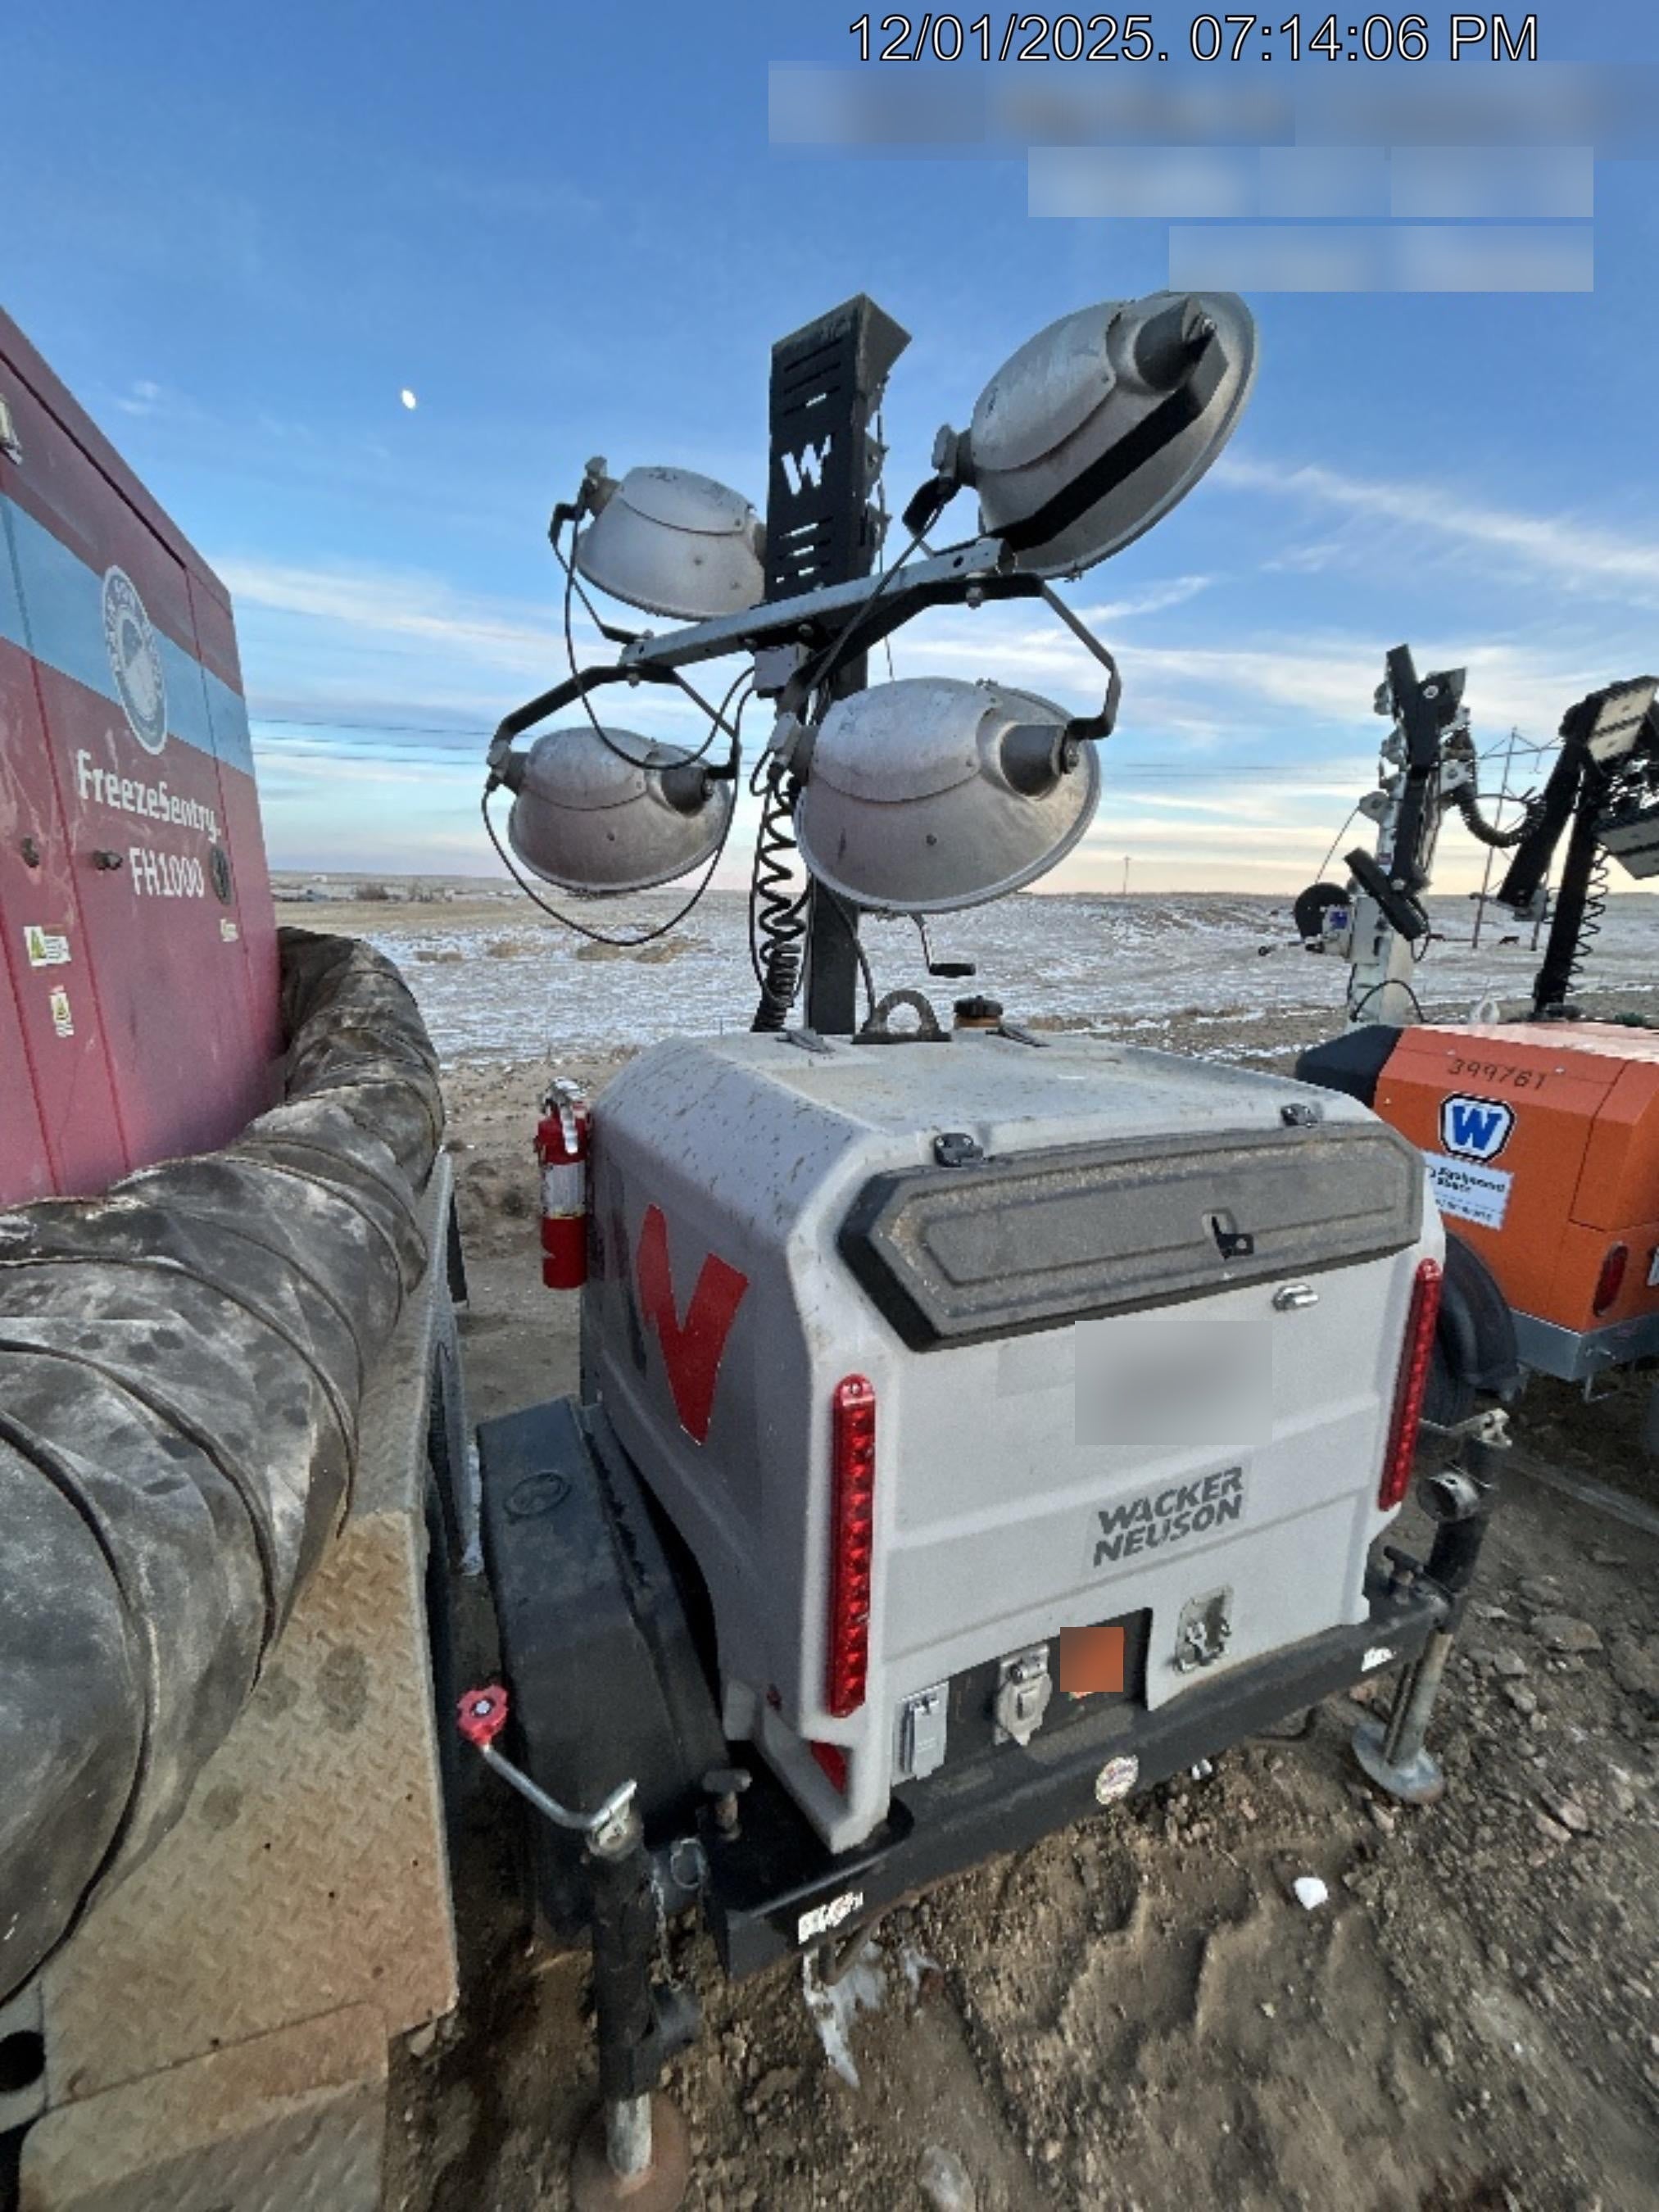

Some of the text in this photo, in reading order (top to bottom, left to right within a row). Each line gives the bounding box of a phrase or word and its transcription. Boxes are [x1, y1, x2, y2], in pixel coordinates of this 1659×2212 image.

[781, 434, 832, 496] W
[129, 847, 205, 898] FH1000
[1449, 1058, 1545, 1090] 399761
[1452, 1106, 1502, 1150] W
[1098, 1467, 1243, 1534] WACKER
[1093, 1495, 1241, 1566] NEUSON
